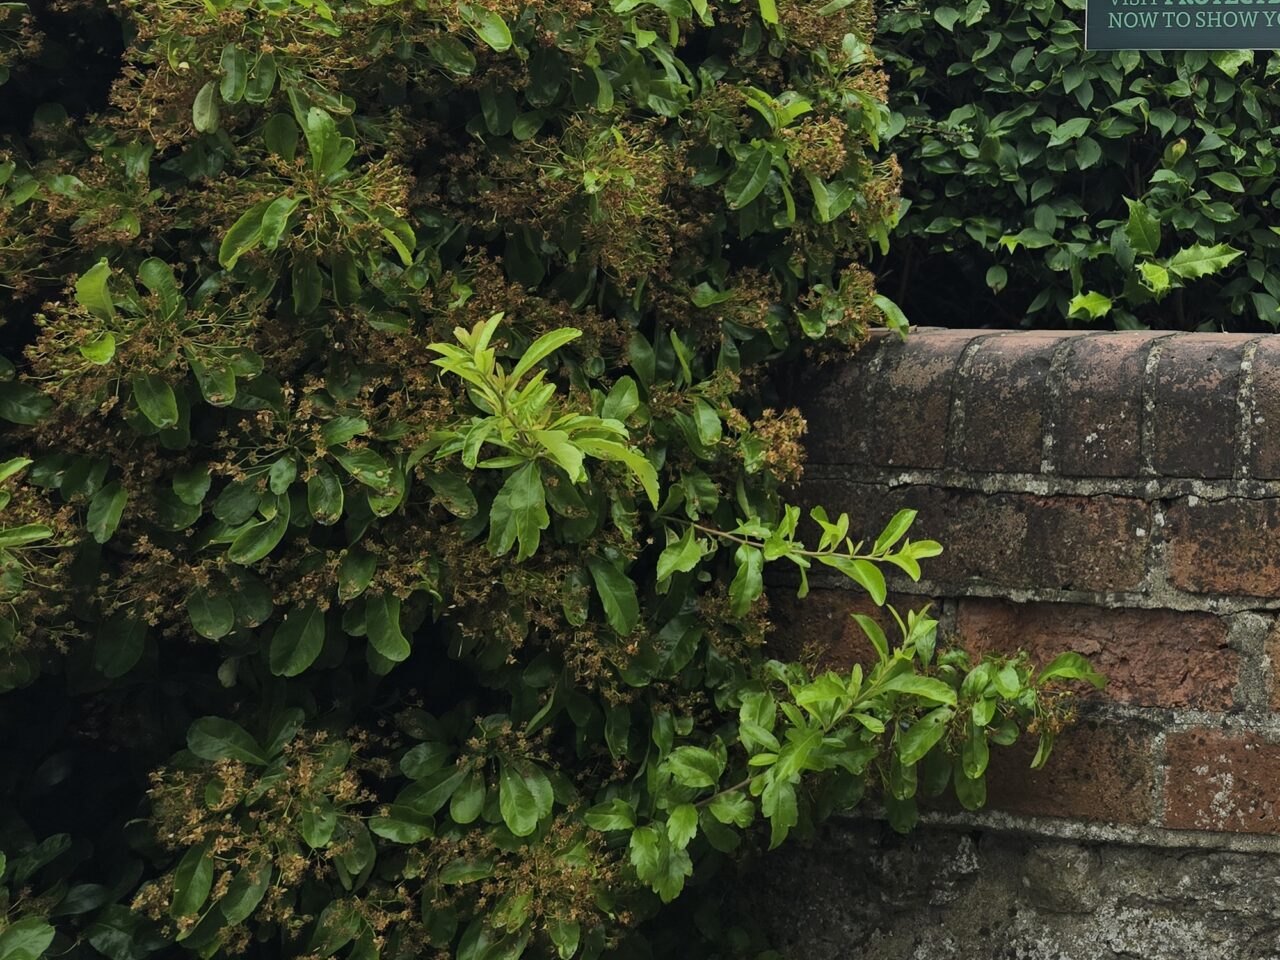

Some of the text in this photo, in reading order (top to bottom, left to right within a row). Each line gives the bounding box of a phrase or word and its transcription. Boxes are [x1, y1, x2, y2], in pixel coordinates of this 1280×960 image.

[1108, 11, 1159, 29] NOW
[1162, 11, 1191, 28] TO
[1195, 11, 1259, 28] SHOW
